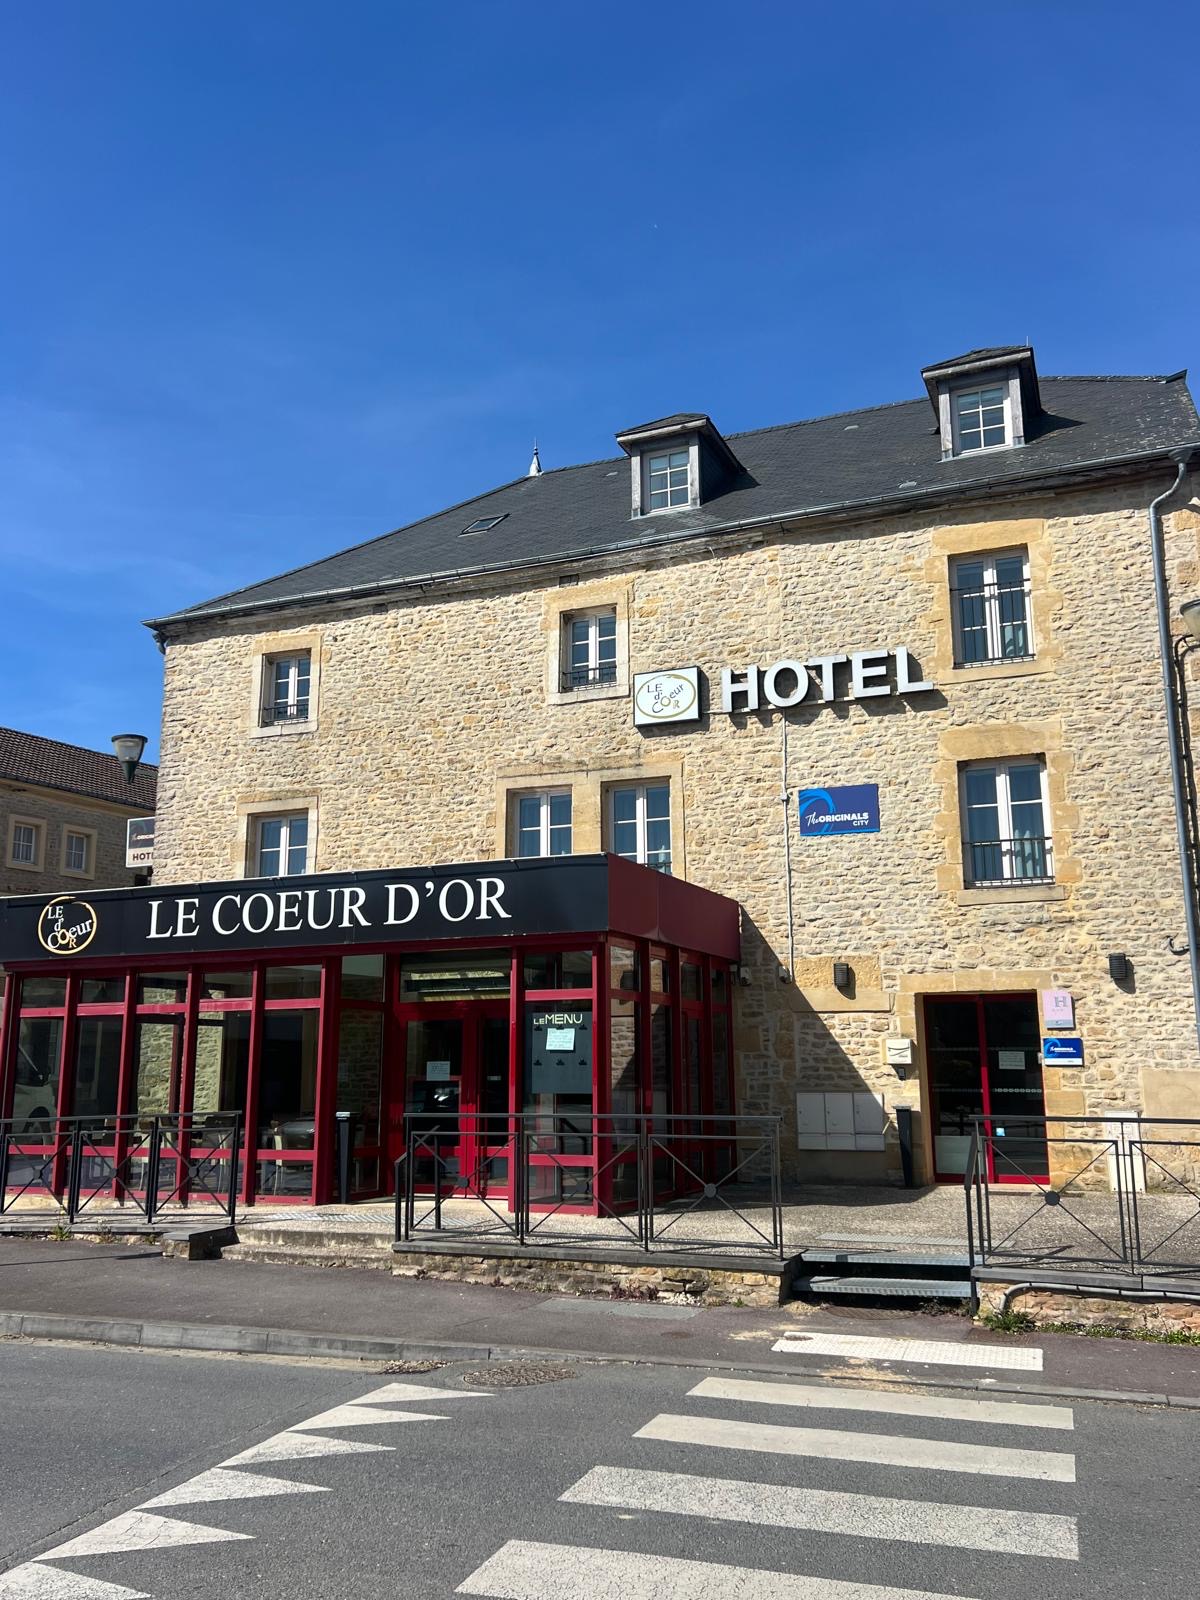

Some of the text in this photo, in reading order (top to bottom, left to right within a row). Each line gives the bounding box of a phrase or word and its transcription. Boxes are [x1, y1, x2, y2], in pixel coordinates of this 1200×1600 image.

[722, 646, 934, 713] HOTEL
[647, 683, 663, 693] LE
[818, 812, 869, 823] ORIGINALS
[132, 852, 154, 861] HOT
[47, 905, 64, 919] LE
[146, 877, 512, 939] LE COEUR D'OR
[544, 1013, 583, 1025] MENU
